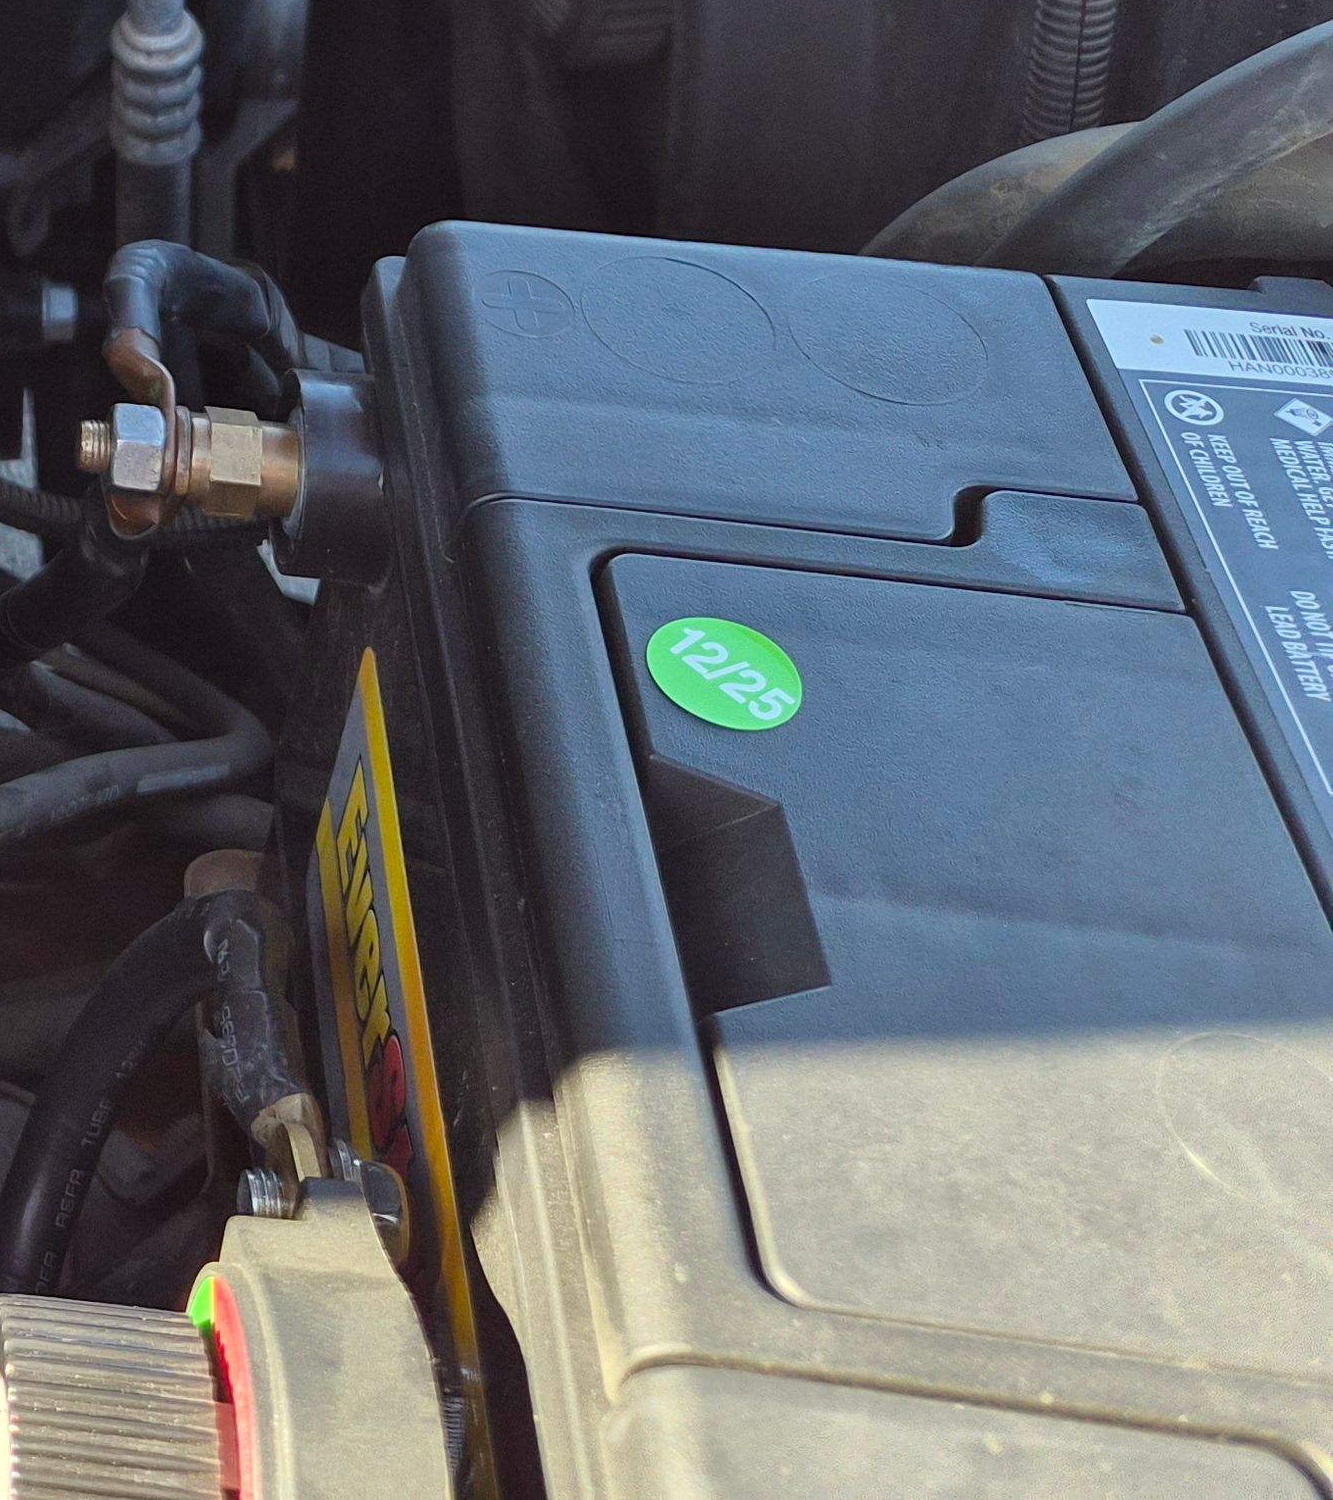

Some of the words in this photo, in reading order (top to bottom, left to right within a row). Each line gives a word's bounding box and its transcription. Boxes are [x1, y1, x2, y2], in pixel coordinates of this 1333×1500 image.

[1249, 321, 1298, 338] Serial
[1300, 326, 1331, 341] No.
[1181, 431, 1204, 449] OF
[1207, 434, 1237, 464] KEEP
[1294, 440, 1331, 484] WATER.
[1189, 449, 1233, 508] CHILDREN
[1222, 465, 1250, 492] OUT
[1268, 437, 1313, 490] MEDICAL
[1296, 493, 1331, 525] HELP
[1234, 491, 1259, 512] OF
[1242, 508, 1279, 550] REACH
[1289, 590, 1320, 610] DO
[1264, 605, 1302, 639] LEAD
[1299, 611, 1333, 639] NOT
[669, 627, 797, 723] 12/25
[1281, 640, 1331, 702] BATTERY
